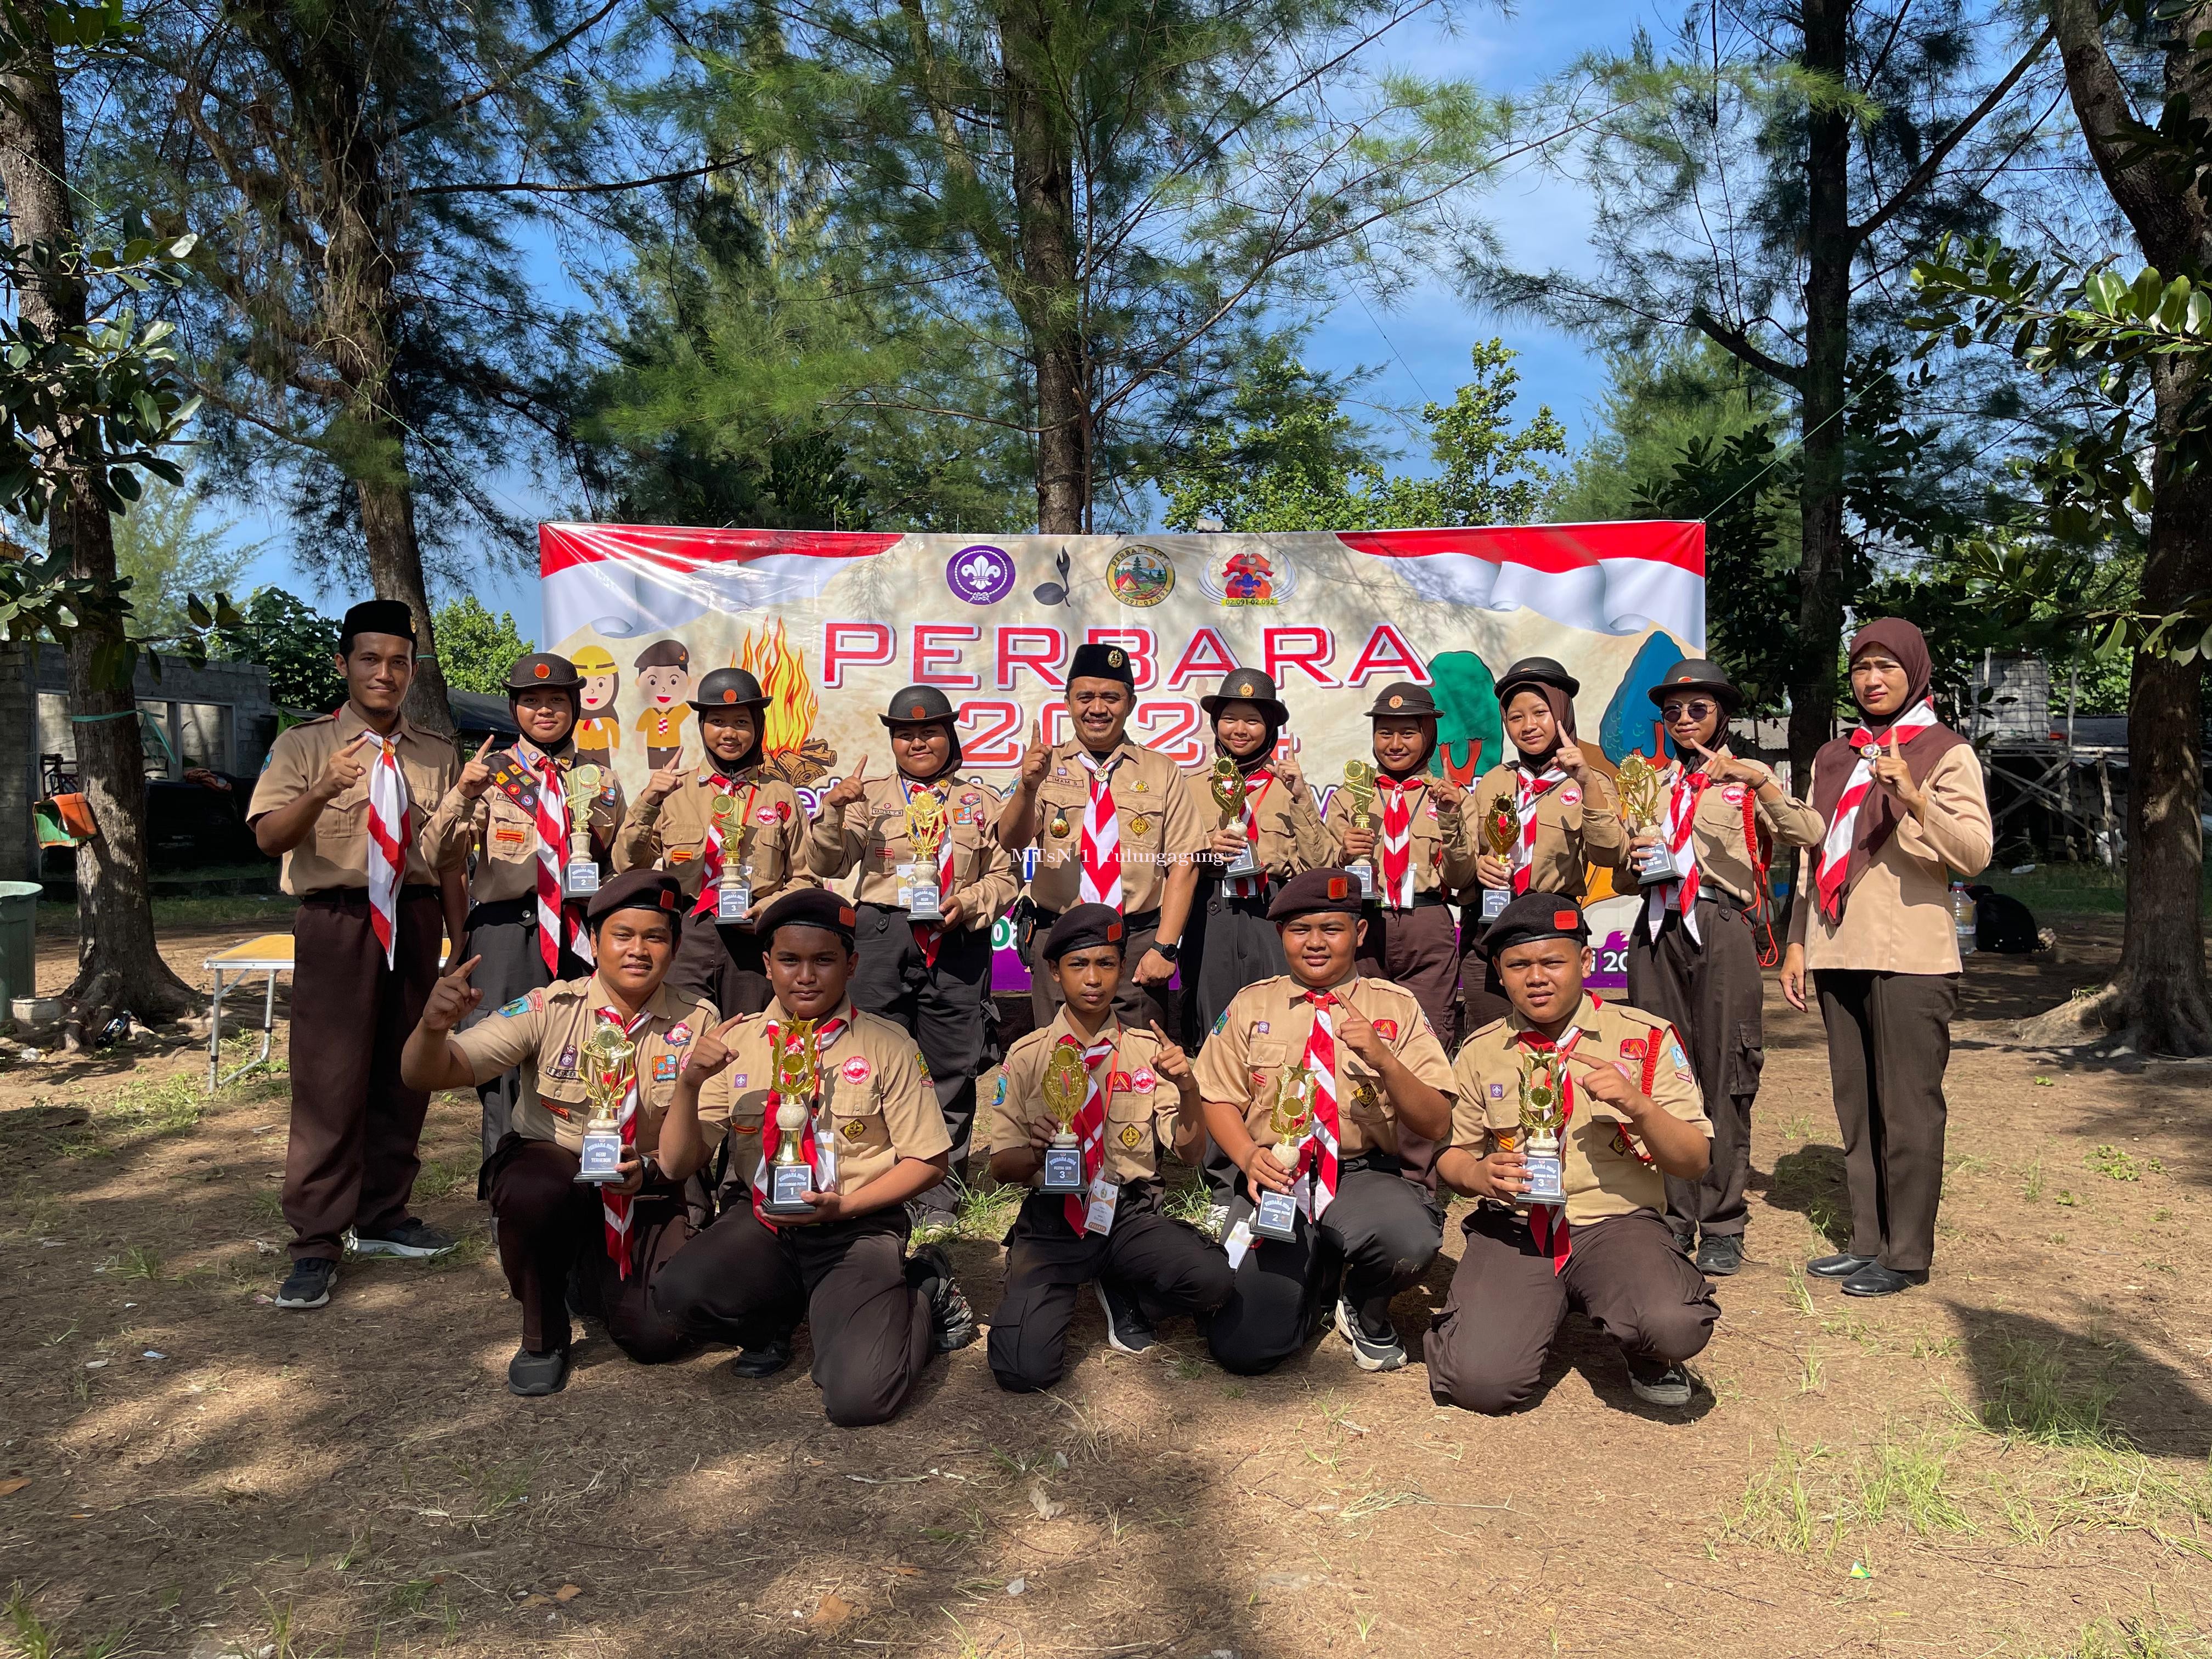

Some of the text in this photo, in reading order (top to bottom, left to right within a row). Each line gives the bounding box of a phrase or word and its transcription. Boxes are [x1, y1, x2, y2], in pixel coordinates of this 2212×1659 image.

[1112, 547, 1149, 567] PERBARA
[1059, 1171, 1065, 1179] 3
[1538, 1178, 1544, 1187] 3
[790, 1187, 794, 1195] 1
[1272, 1214, 1279, 1222] 2
